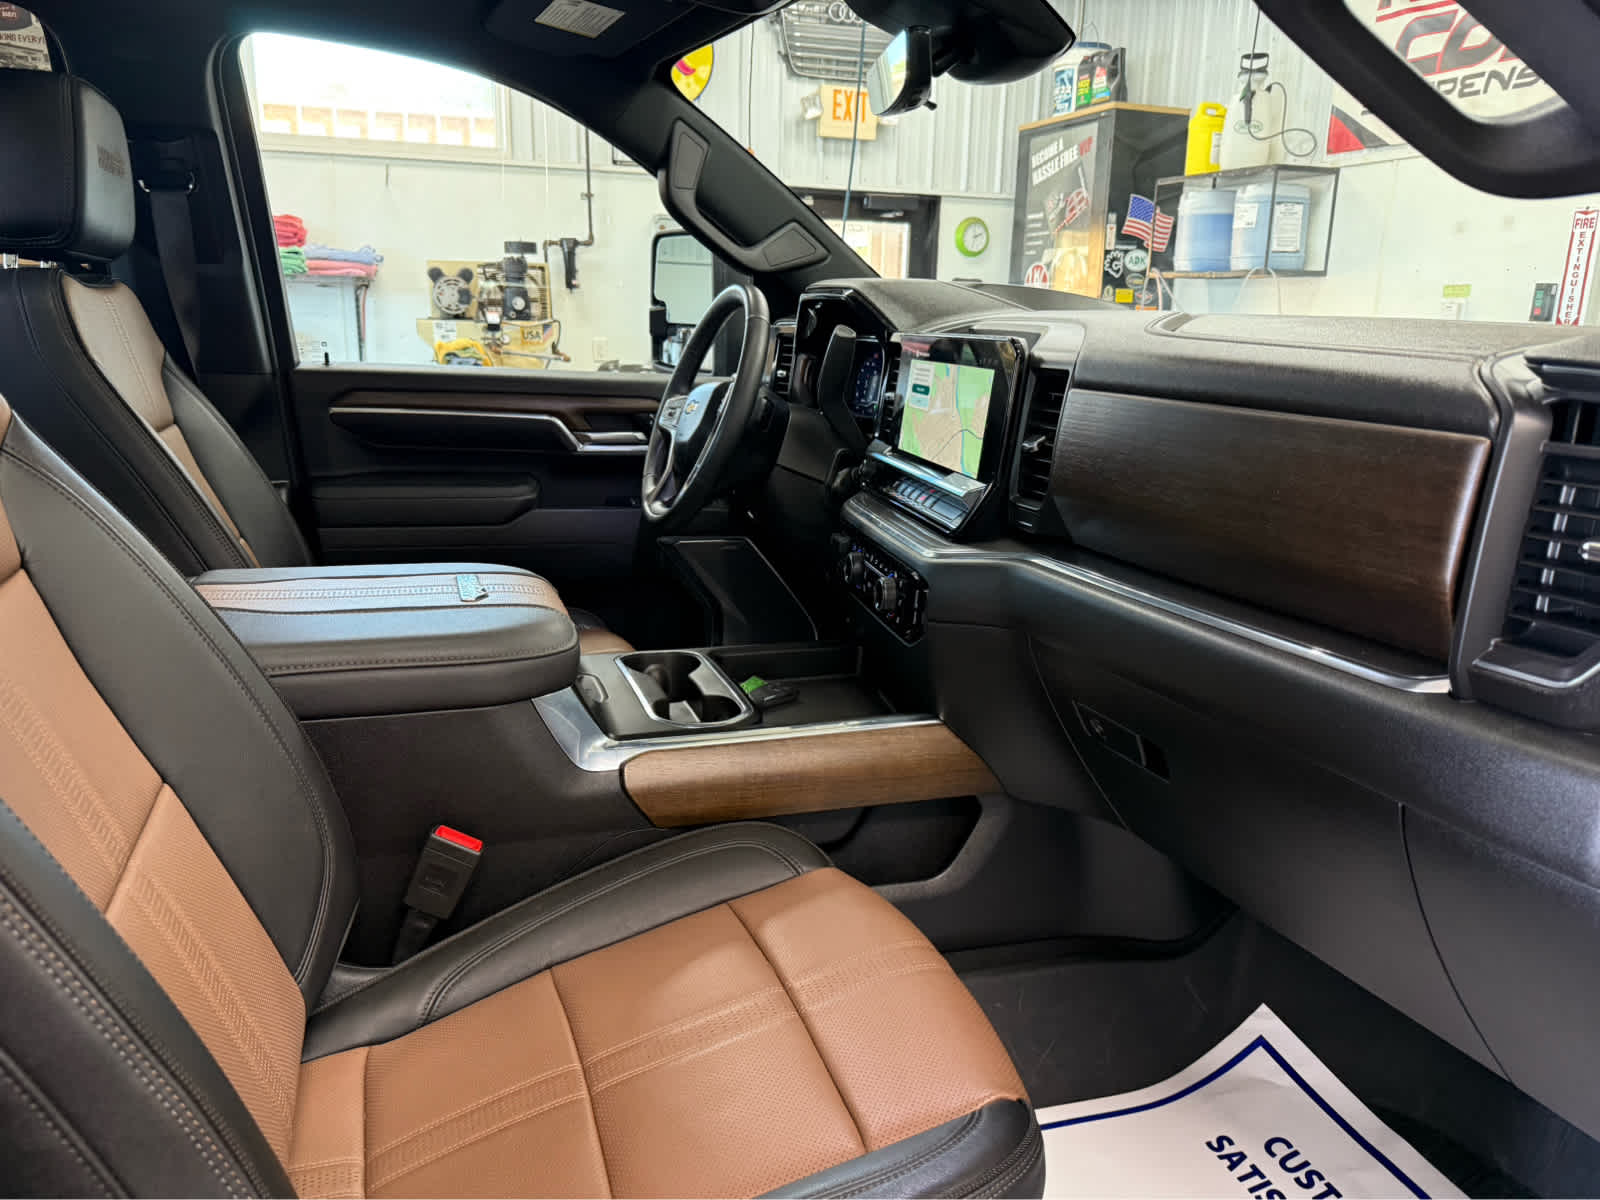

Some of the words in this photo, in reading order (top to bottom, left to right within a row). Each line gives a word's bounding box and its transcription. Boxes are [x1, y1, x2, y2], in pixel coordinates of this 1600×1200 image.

[1431, 66, 1541, 98] PENS
[1575, 217, 1595, 229] FIRE
[1127, 255, 1146, 265] ADK
[1563, 231, 1586, 325] EXTINGUISHER
[521, 329, 541, 340] USA
[1264, 1137, 1343, 1200] CUST
